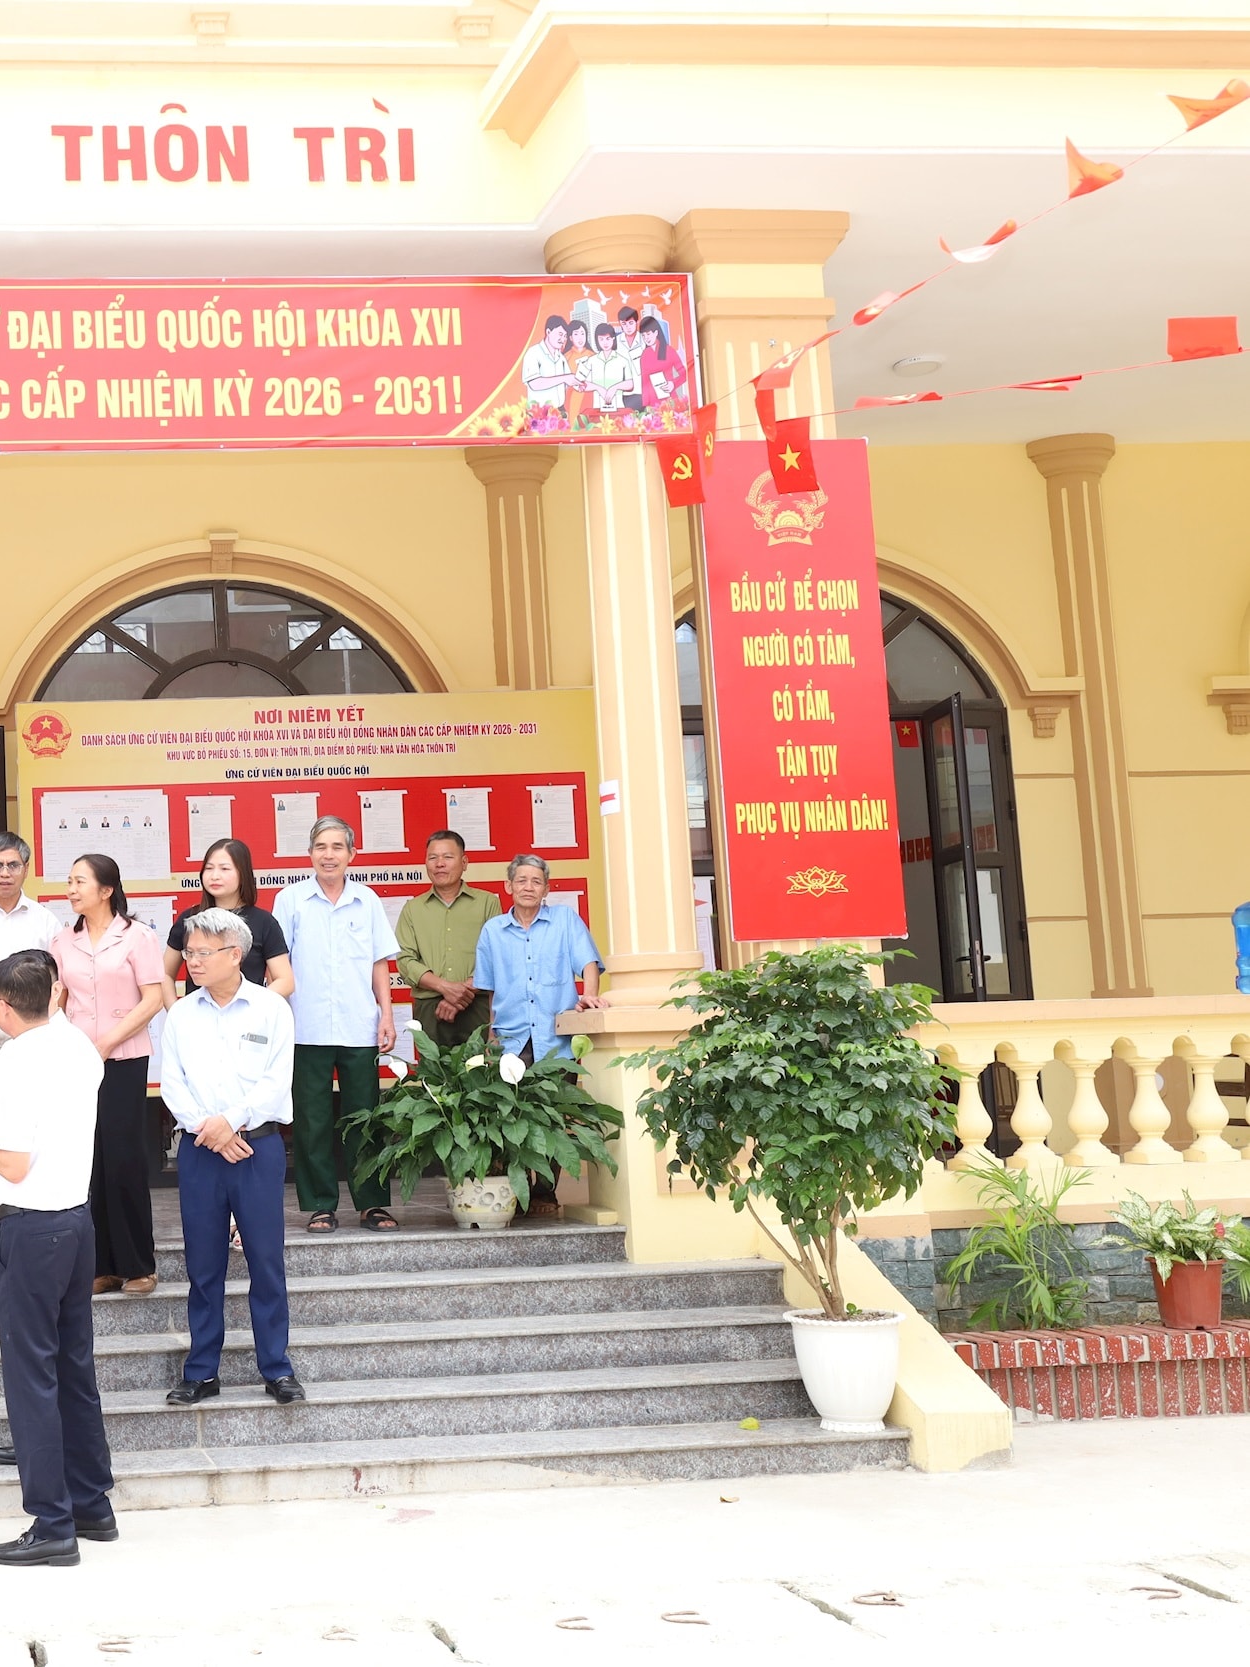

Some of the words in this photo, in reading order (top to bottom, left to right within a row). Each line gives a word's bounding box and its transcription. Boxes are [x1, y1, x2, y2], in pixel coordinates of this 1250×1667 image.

[51, 103, 249, 182] THÔN
[294, 97, 415, 182] TRÌ
[7, 311, 62, 358] ĐẠI
[73, 295, 146, 349] BIỂU
[157, 296, 242, 353] QUỐC
[253, 301, 306, 356] HỘI
[316, 301, 403, 347] KHÓA
[411, 308, 462, 346] XVI
[22, 365, 85, 419] CẤP
[97, 370, 203, 426] NHIỆM
[214, 369, 253, 416] KỲ
[265, 377, 342, 416] 2026
[375, 376, 463, 417] 2031!
[730, 571, 761, 612] BẦU
[765, 571, 786, 611] CỬ
[793, 568, 814, 611] ĐỂ
[817, 580, 858, 616] CHỌN
[743, 628, 790, 666] NGƯỜI
[793, 629, 814, 666] CÓ
[817, 628, 855, 668] TÂM,
[254, 709, 283, 724] NƠI
[288, 707, 331, 723] NIÊM
[337, 704, 364, 722] YẾT
[773, 684, 793, 721] CÓ
[796, 679, 835, 724] TẦM,
[81, 736, 103, 746] DANH
[105, 733, 126, 746] SÁCH
[128, 732, 145, 745] ỨNG
[146, 732, 159, 745] CỬ
[159, 732, 178, 745] VIÊN
[179, 731, 193, 744] ĐẠI
[195, 729, 213, 743] BIỂU
[215, 728, 236, 743] QUỐC
[237, 728, 251, 743] HỘI
[253, 728, 274, 741] KHÓA
[276, 729, 289, 740] XVI
[290, 727, 301, 740] VÀ
[302, 727, 316, 740] ĐẠI
[318, 725, 336, 739] BIỂU
[337, 725, 351, 740] HỘI
[376, 726, 398, 737] NHÂN
[400, 725, 417, 737] DÂN
[418, 725, 435, 737] CÁC
[436, 722, 452, 736] CẤP
[453, 723, 479, 737] NHIỆM
[480, 723, 491, 734] KỲ
[493, 723, 512, 735] 2026
[519, 723, 537, 734] 2031
[225, 768, 244, 778] ỨNG
[247, 766, 260, 778] CỬ
[262, 768, 282, 777] VIÊN
[286, 767, 300, 779] ĐẠI
[304, 764, 324, 776] BIỂU
[327, 765, 351, 776] QUỐC
[354, 764, 369, 777] HỘI
[776, 740, 807, 783] TẬN
[810, 745, 837, 783] TỤY
[736, 802, 777, 840] PHỤC
[780, 802, 800, 839] VỤ
[804, 794, 847, 832] NHÂN
[850, 793, 888, 830] DÂN!
[260, 874, 285, 886] ĐỒNG
[370, 870, 389, 882] PHỐ
[392, 870, 404, 881] HÀ
[406, 870, 423, 883] NỘI
